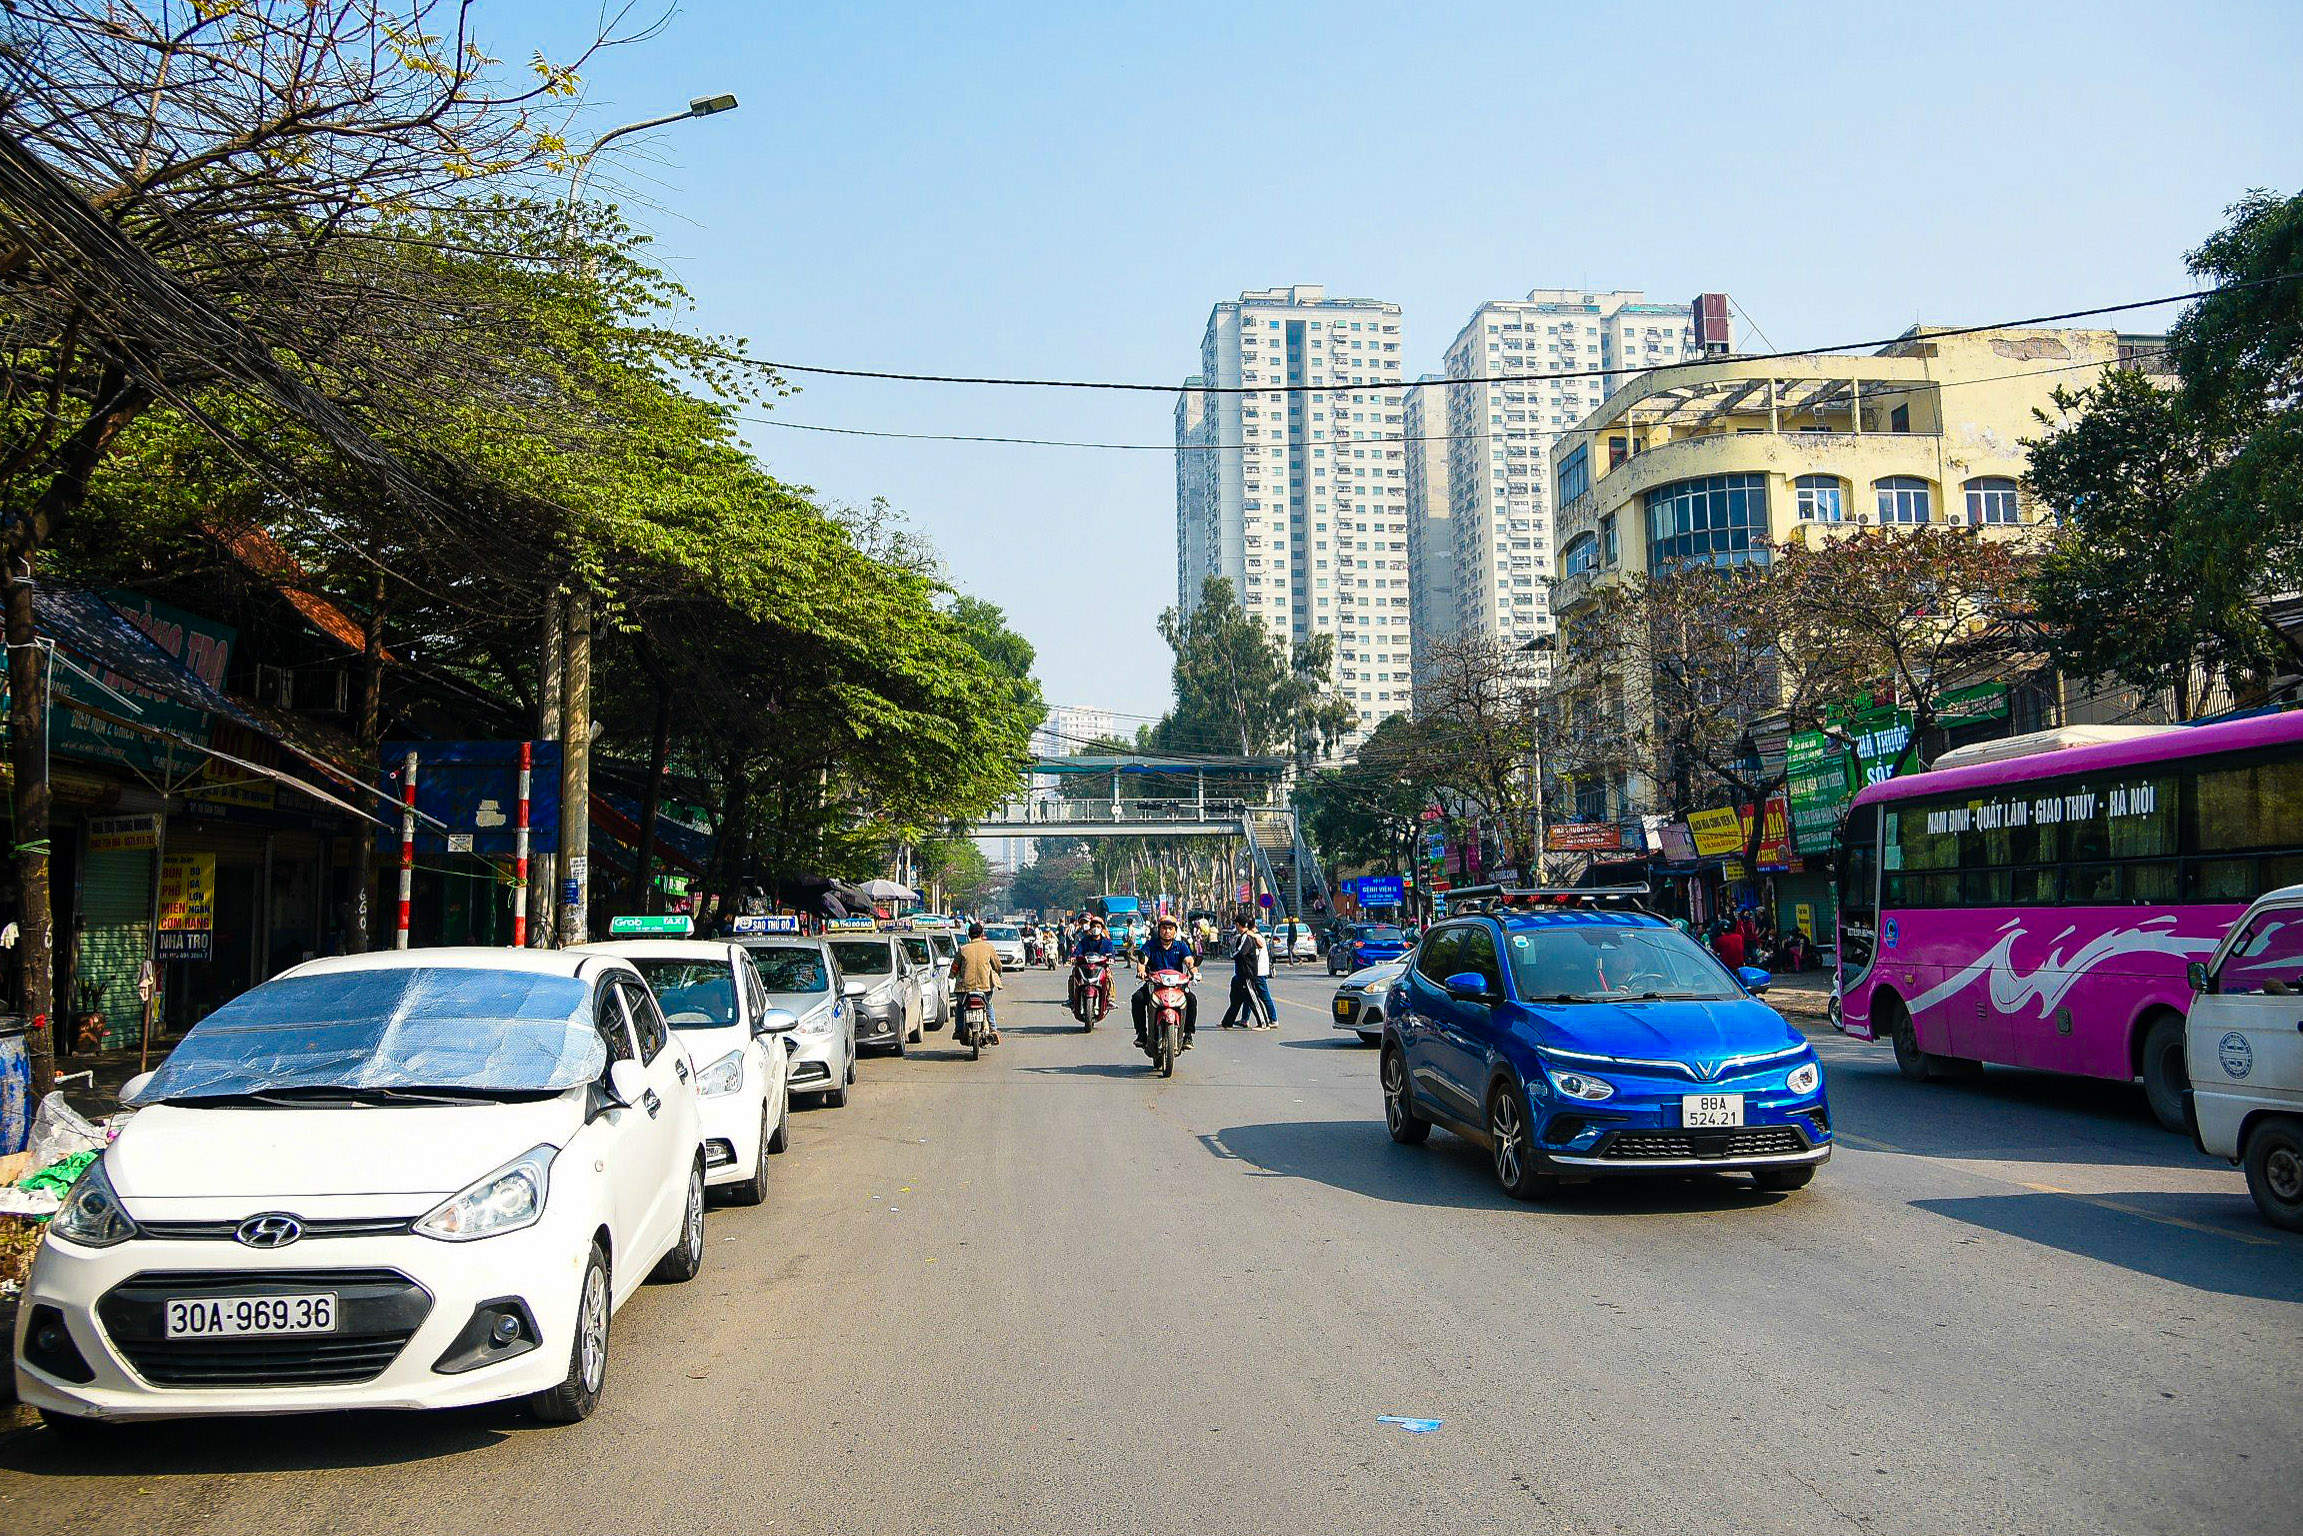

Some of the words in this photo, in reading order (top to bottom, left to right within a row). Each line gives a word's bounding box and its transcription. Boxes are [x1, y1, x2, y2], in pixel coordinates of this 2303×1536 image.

[1928, 811, 1947, 835] NAM
[1949, 807, 1970, 836] ĐỊNH
[1976, 796, 2003, 832] QUẤT
[2005, 797, 2027, 827] LÂM
[2035, 798, 2062, 824] GIAO
[2065, 784, 2095, 821] THỦY
[2109, 783, 2127, 817] HÀ
[2131, 780, 2154, 820] NỘI
[1362, 885, 1378, 894] BỆNH
[1379, 885, 1392, 893] VIỆN
[184, 917, 210, 929] RANG
[614, 917, 643, 927] Grab
[664, 916, 685, 926] TAXI
[753, 920, 766, 931] SAO
[768, 918, 780, 930] THỦ
[781, 918, 791, 930] ĐÔ
[160, 931, 184, 950] NHÀ
[1701, 1097, 1726, 1110] 88A
[1690, 1112, 1736, 1125] 524.21
[172, 1298, 330, 1333] 30A-969.36
